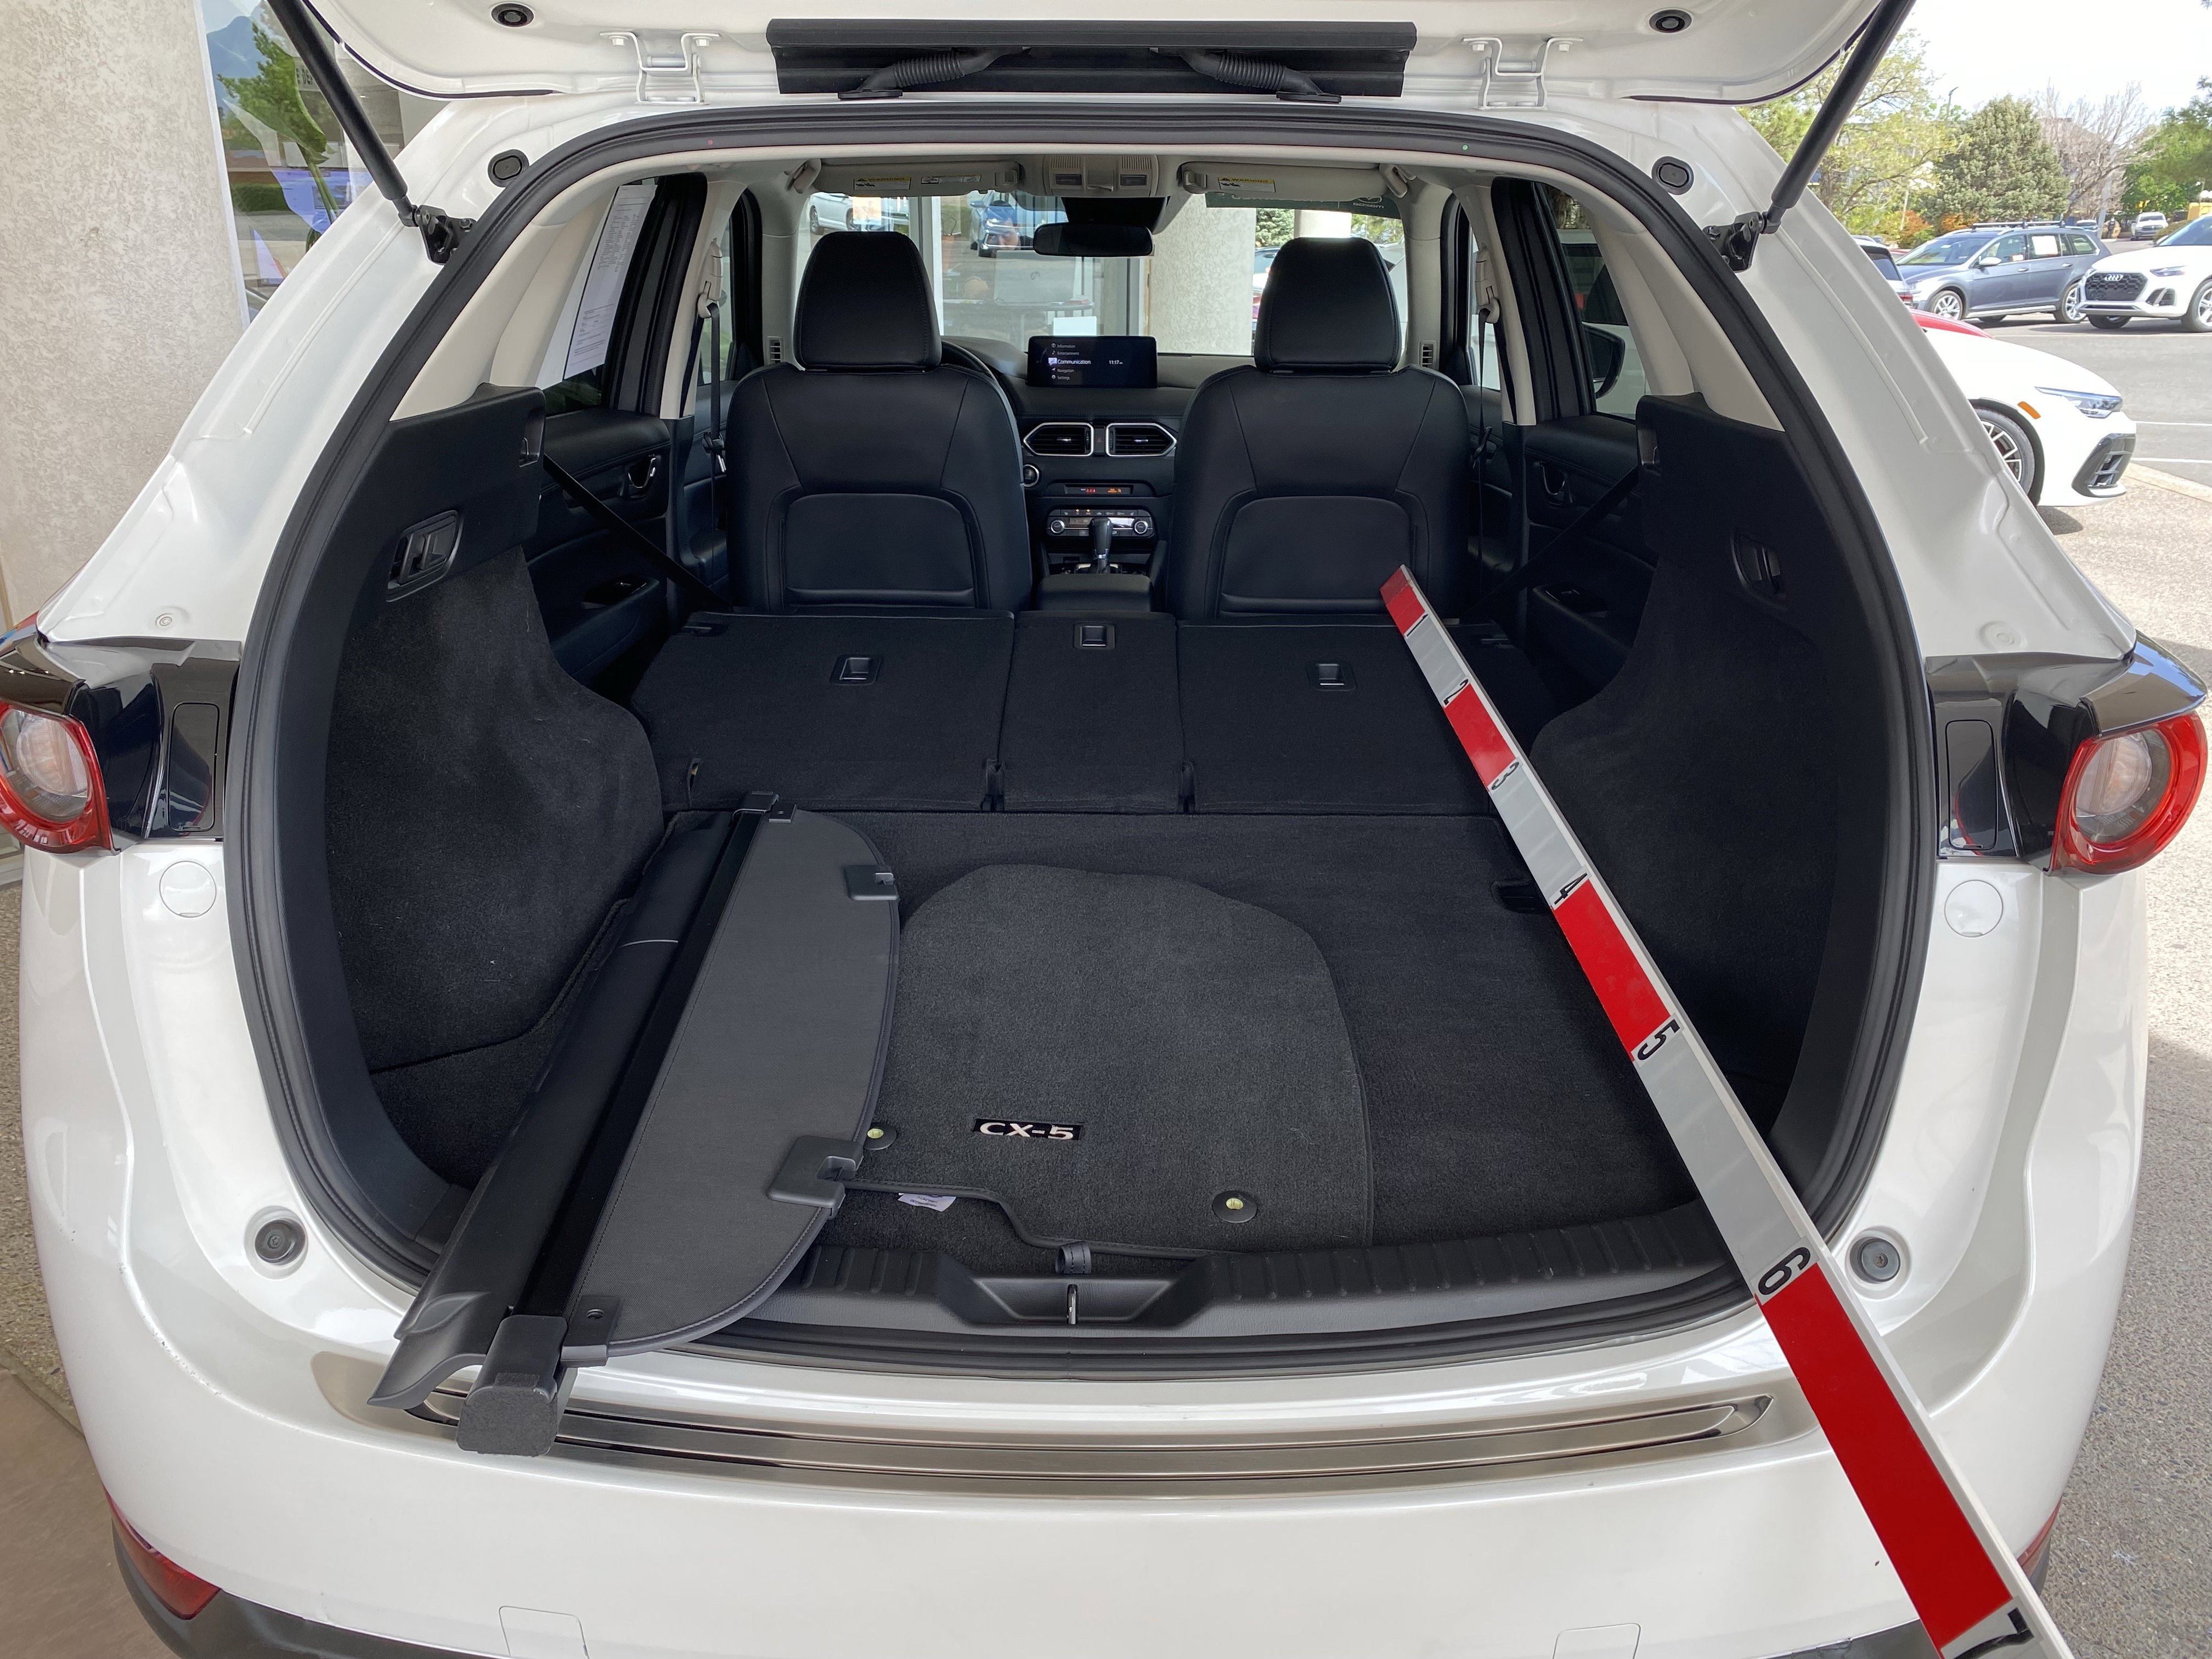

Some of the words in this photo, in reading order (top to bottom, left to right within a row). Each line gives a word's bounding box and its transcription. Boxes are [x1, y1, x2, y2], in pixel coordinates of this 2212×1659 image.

[1407, 614, 1428, 637] 1
[1443, 679, 1468, 704] 2
[1491, 761, 1520, 791] 3
[1554, 872, 1588, 905] 4
[1637, 1019, 1680, 1061] 5
[980, 1122, 1074, 1140] CX-5
[1758, 1246, 1811, 1295] 6
